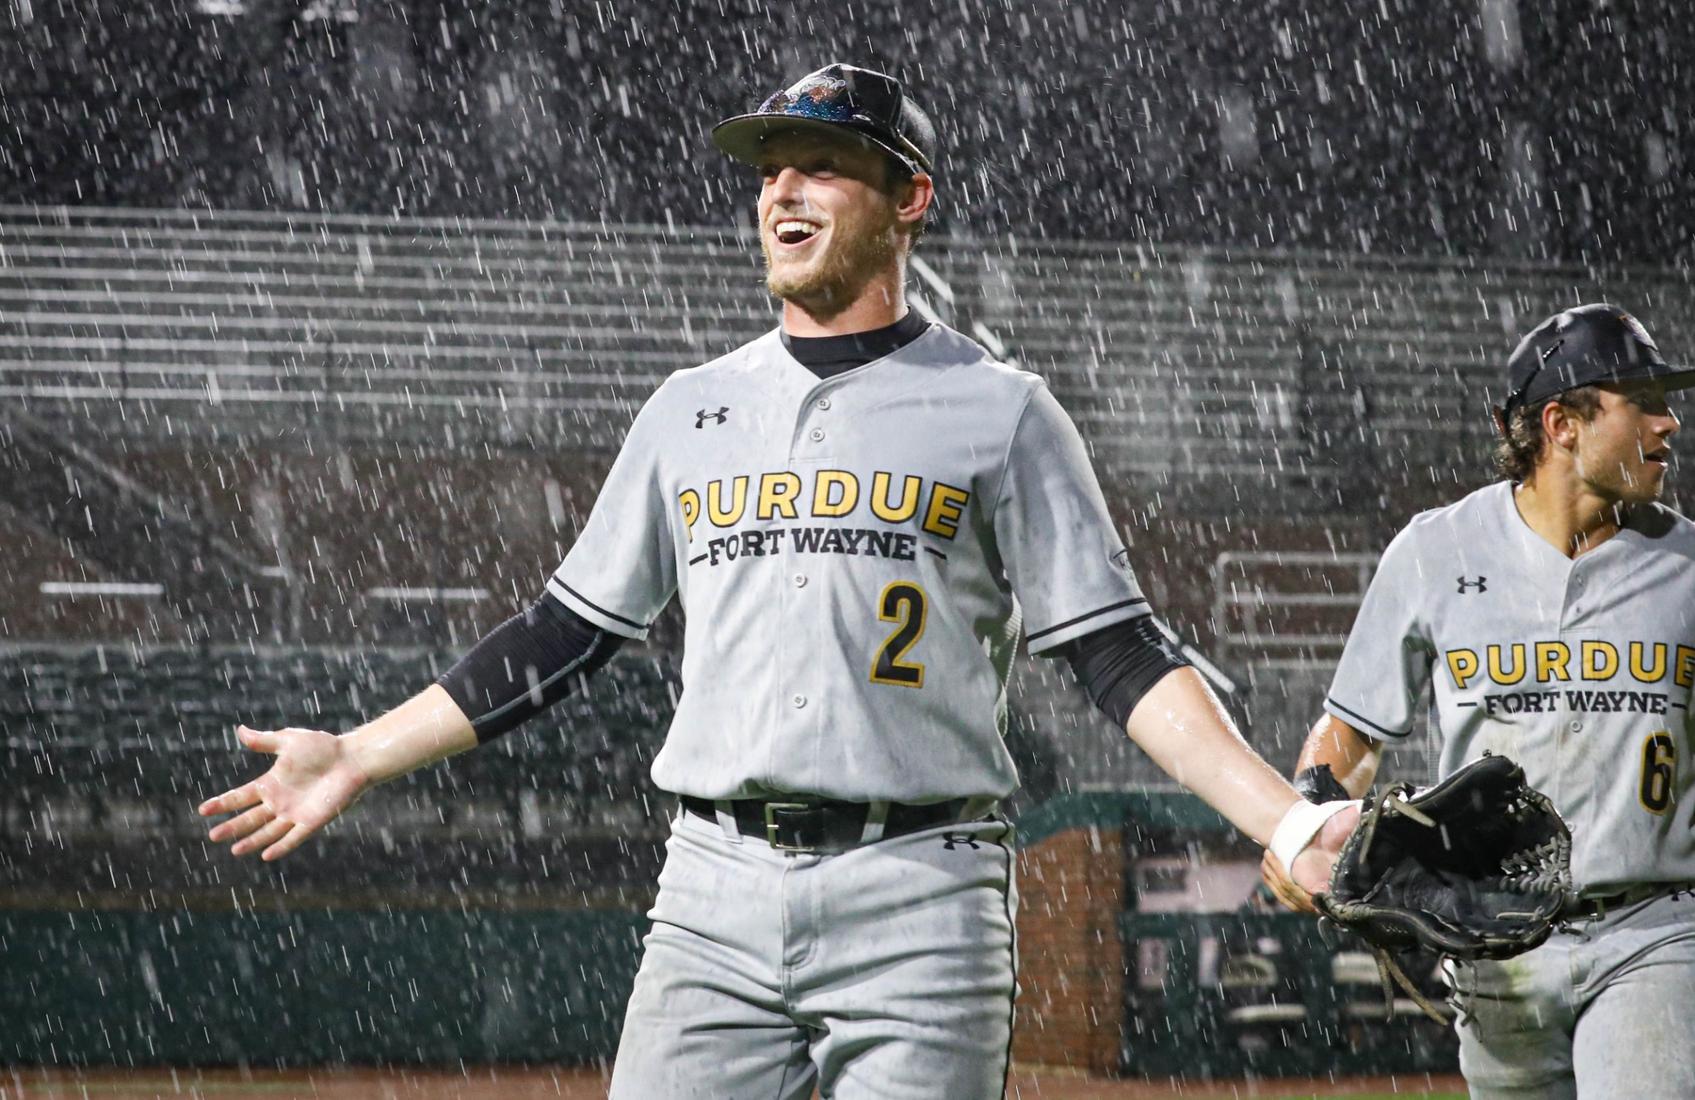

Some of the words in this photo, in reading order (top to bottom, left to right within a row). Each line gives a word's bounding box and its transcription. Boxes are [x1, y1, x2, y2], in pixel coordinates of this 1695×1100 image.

[679, 470, 970, 542] PURDUE
[869, 579, 928, 689] 2
[1446, 640, 1695, 689] PURDUE
[1639, 732, 1678, 815] 6
